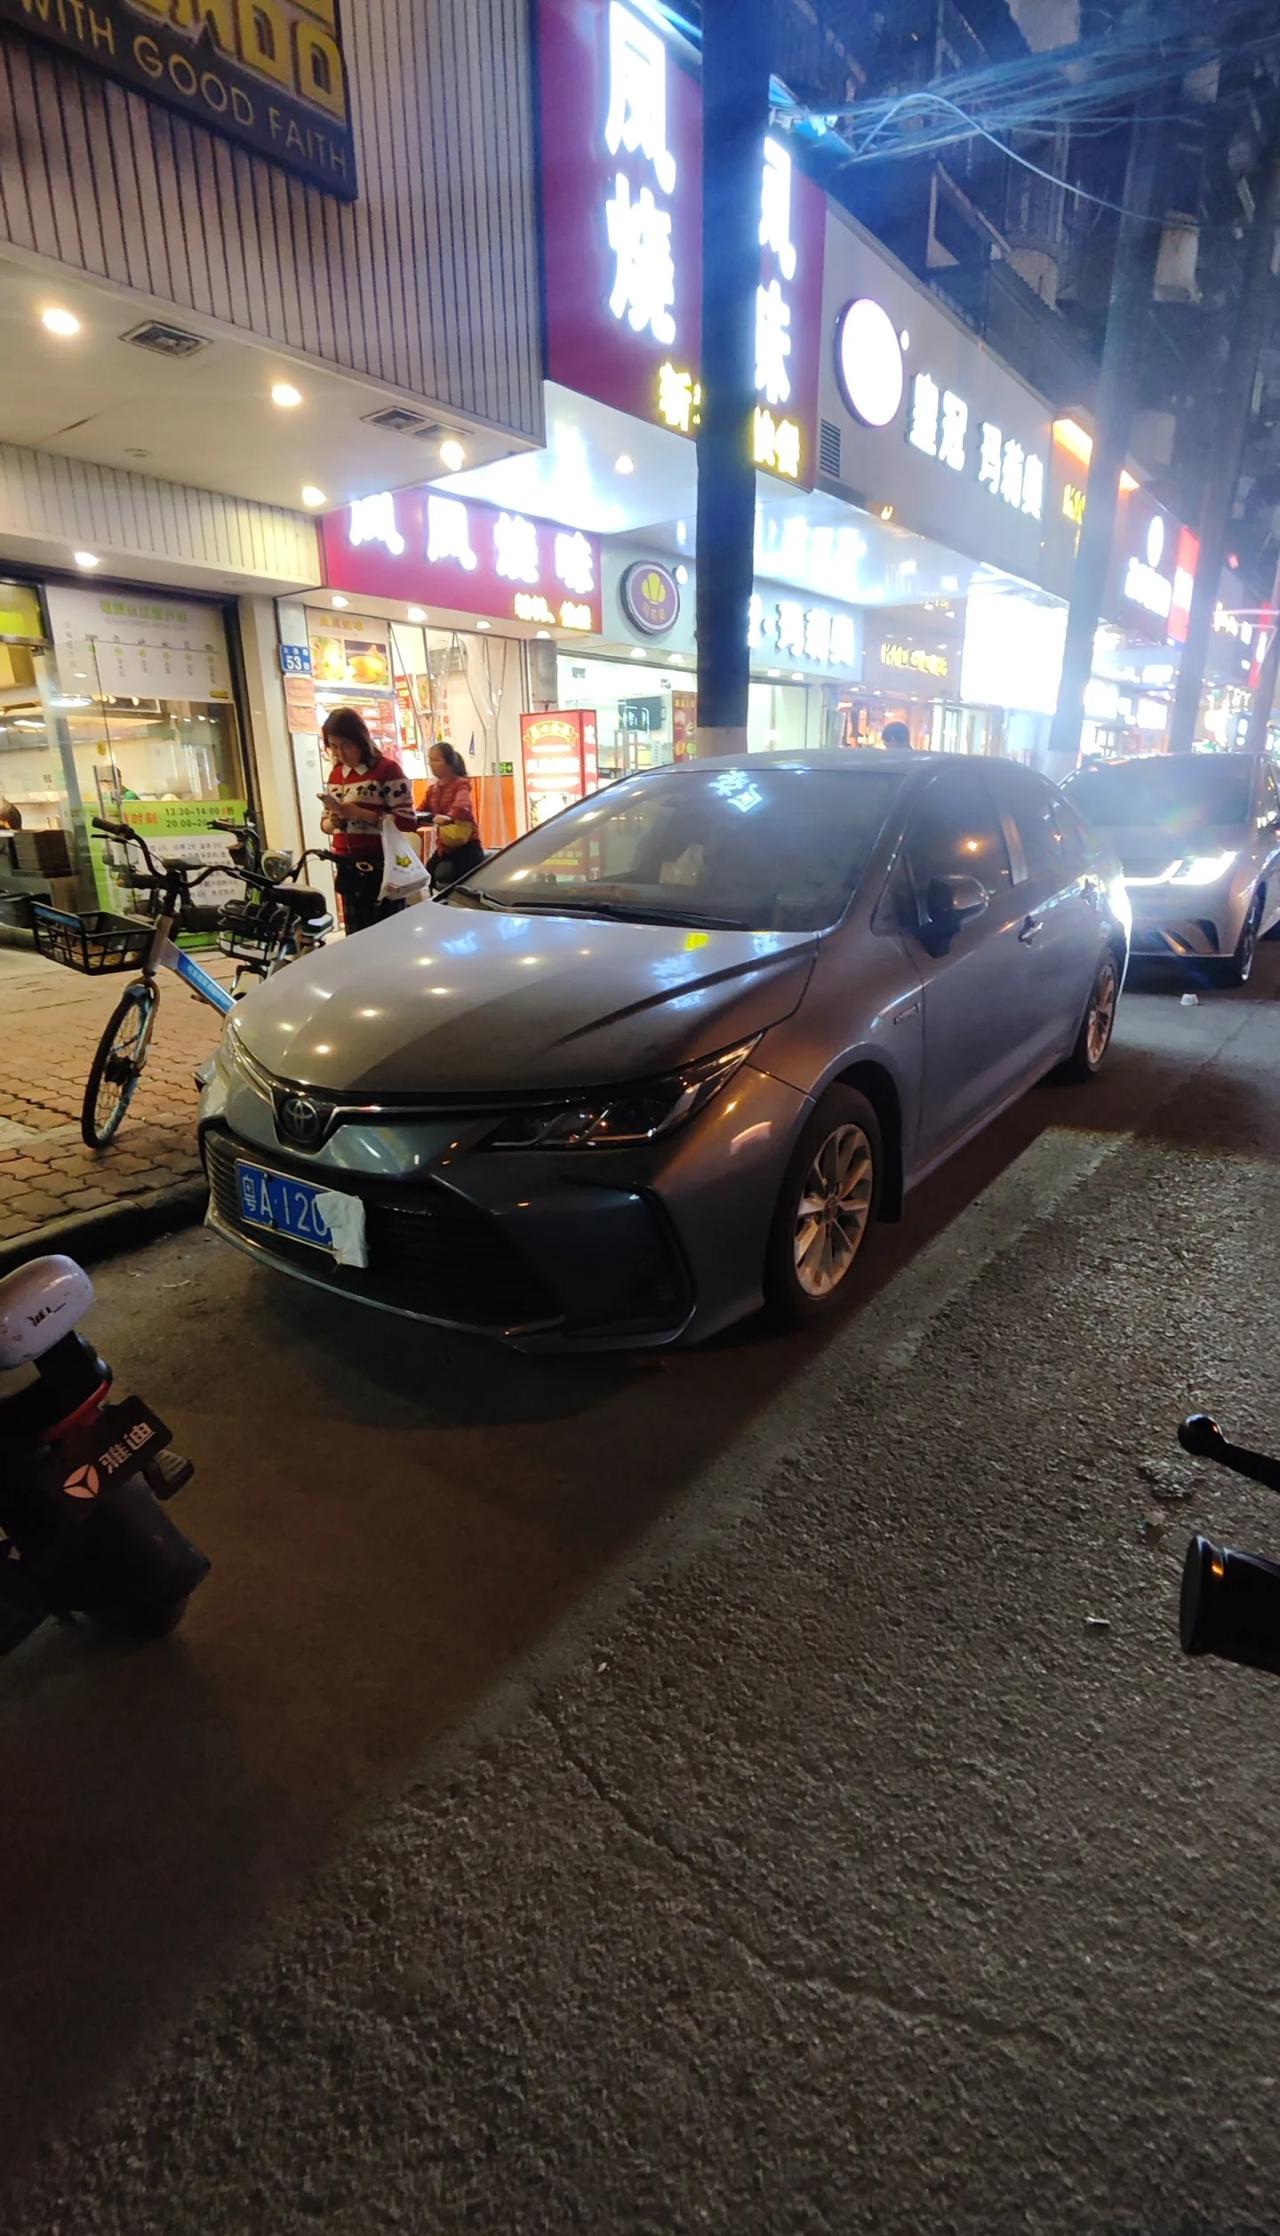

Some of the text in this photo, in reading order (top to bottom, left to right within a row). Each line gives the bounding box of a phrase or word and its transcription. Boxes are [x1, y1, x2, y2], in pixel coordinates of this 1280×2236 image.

[133, 34, 255, 127] GOOD
[268, 106, 347, 178] FAITH
[98, 1421, 156, 1474] 雅迪
